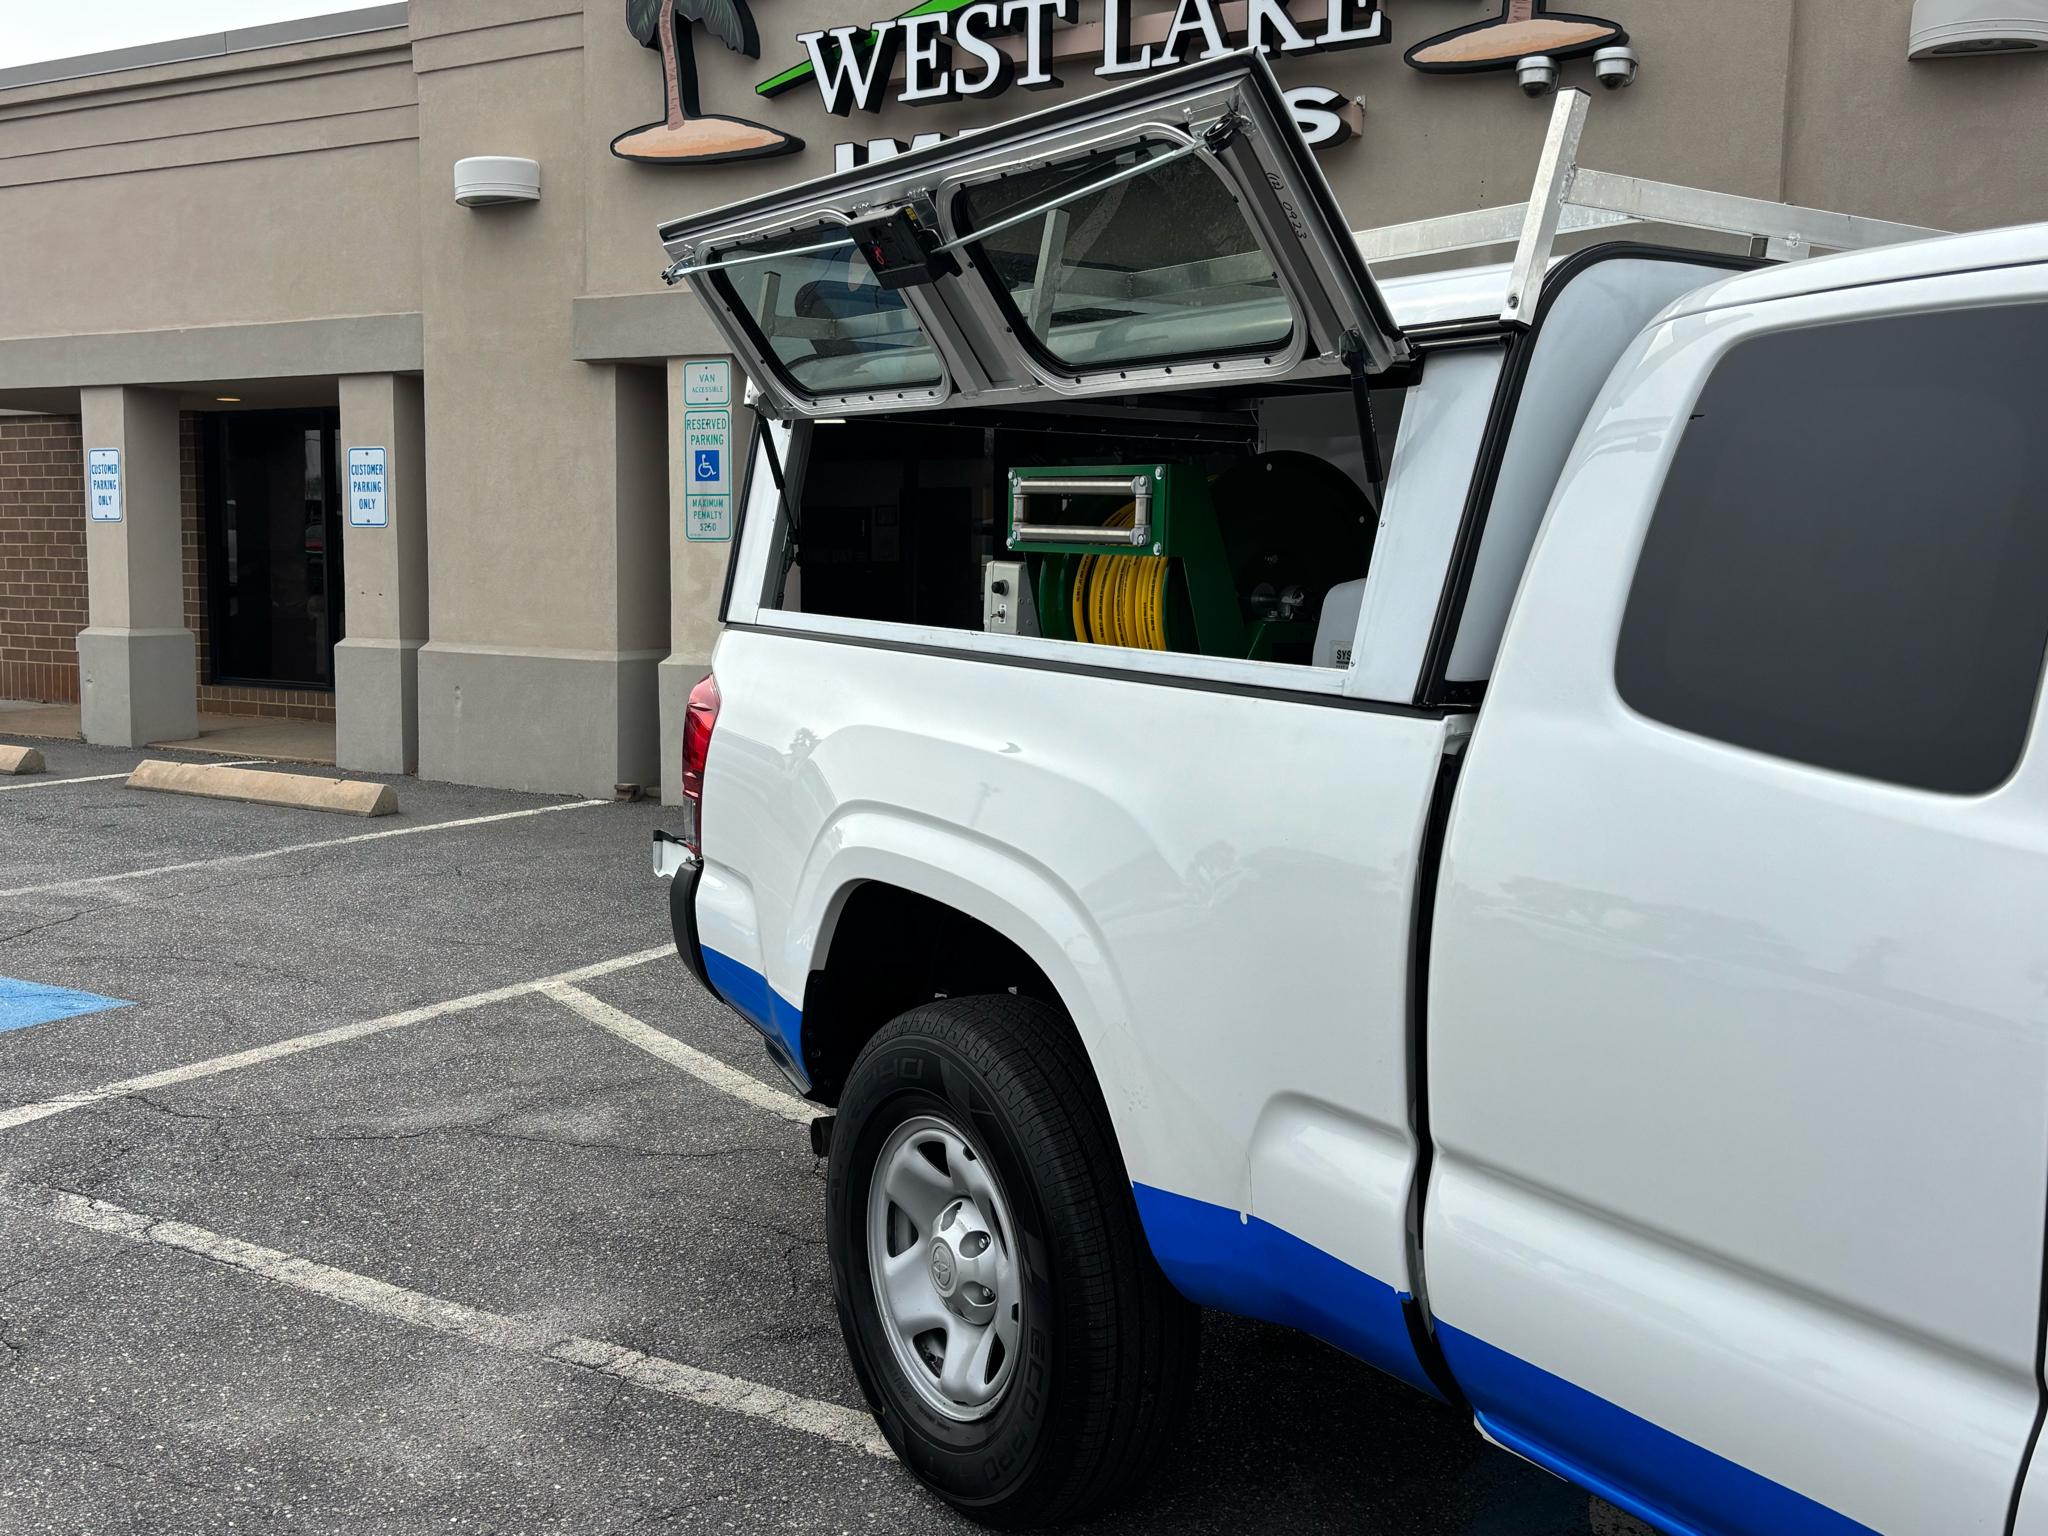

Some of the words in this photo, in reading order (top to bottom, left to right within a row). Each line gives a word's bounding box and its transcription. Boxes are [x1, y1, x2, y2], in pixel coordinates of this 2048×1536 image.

[797, 0, 1066, 114] WEST
[1094, 0, 1383, 75] LAKE
[1282, 201, 1307, 240] 0923
[699, 374, 715, 382] VAN
[687, 419, 726, 430] RESERVED
[691, 434, 723, 445] PARKING
[92, 464, 117, 474] CUSTOMER
[351, 464, 383, 475] CUSTOMER
[93, 480, 116, 490] PARKING
[353, 481, 381, 492] PARKING
[98, 496, 112, 505] ONLY
[359, 499, 376, 509] ONLY
[692, 499, 723, 507] MAXIMUM
[694, 511, 722, 519] PENALTY
